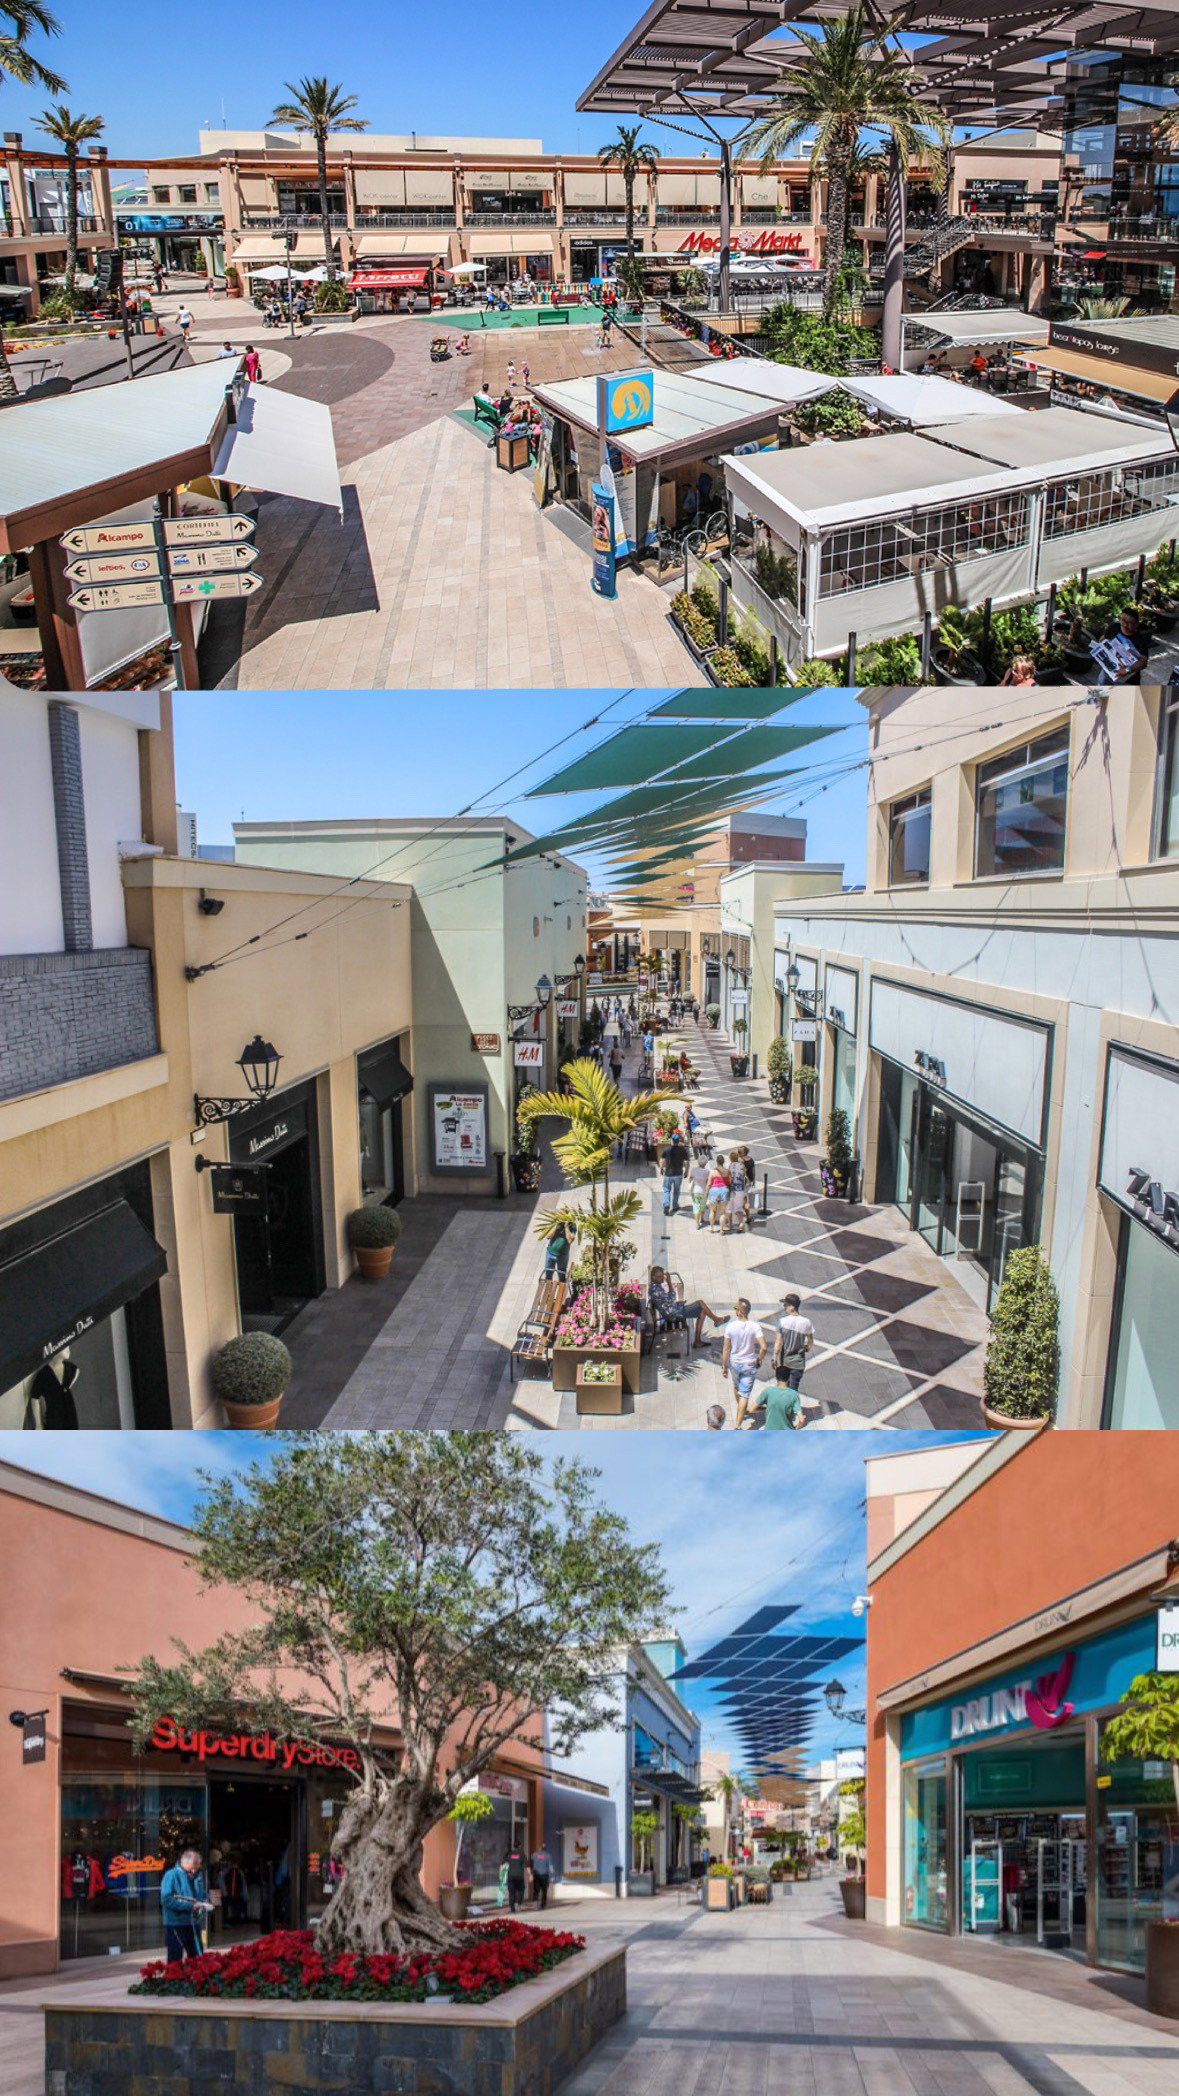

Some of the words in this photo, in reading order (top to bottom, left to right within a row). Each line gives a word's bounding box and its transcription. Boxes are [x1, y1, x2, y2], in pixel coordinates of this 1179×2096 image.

[678, 231, 739, 252] Meda
[750, 230, 803, 250] Markt
[97, 533, 144, 543] Alcampo
